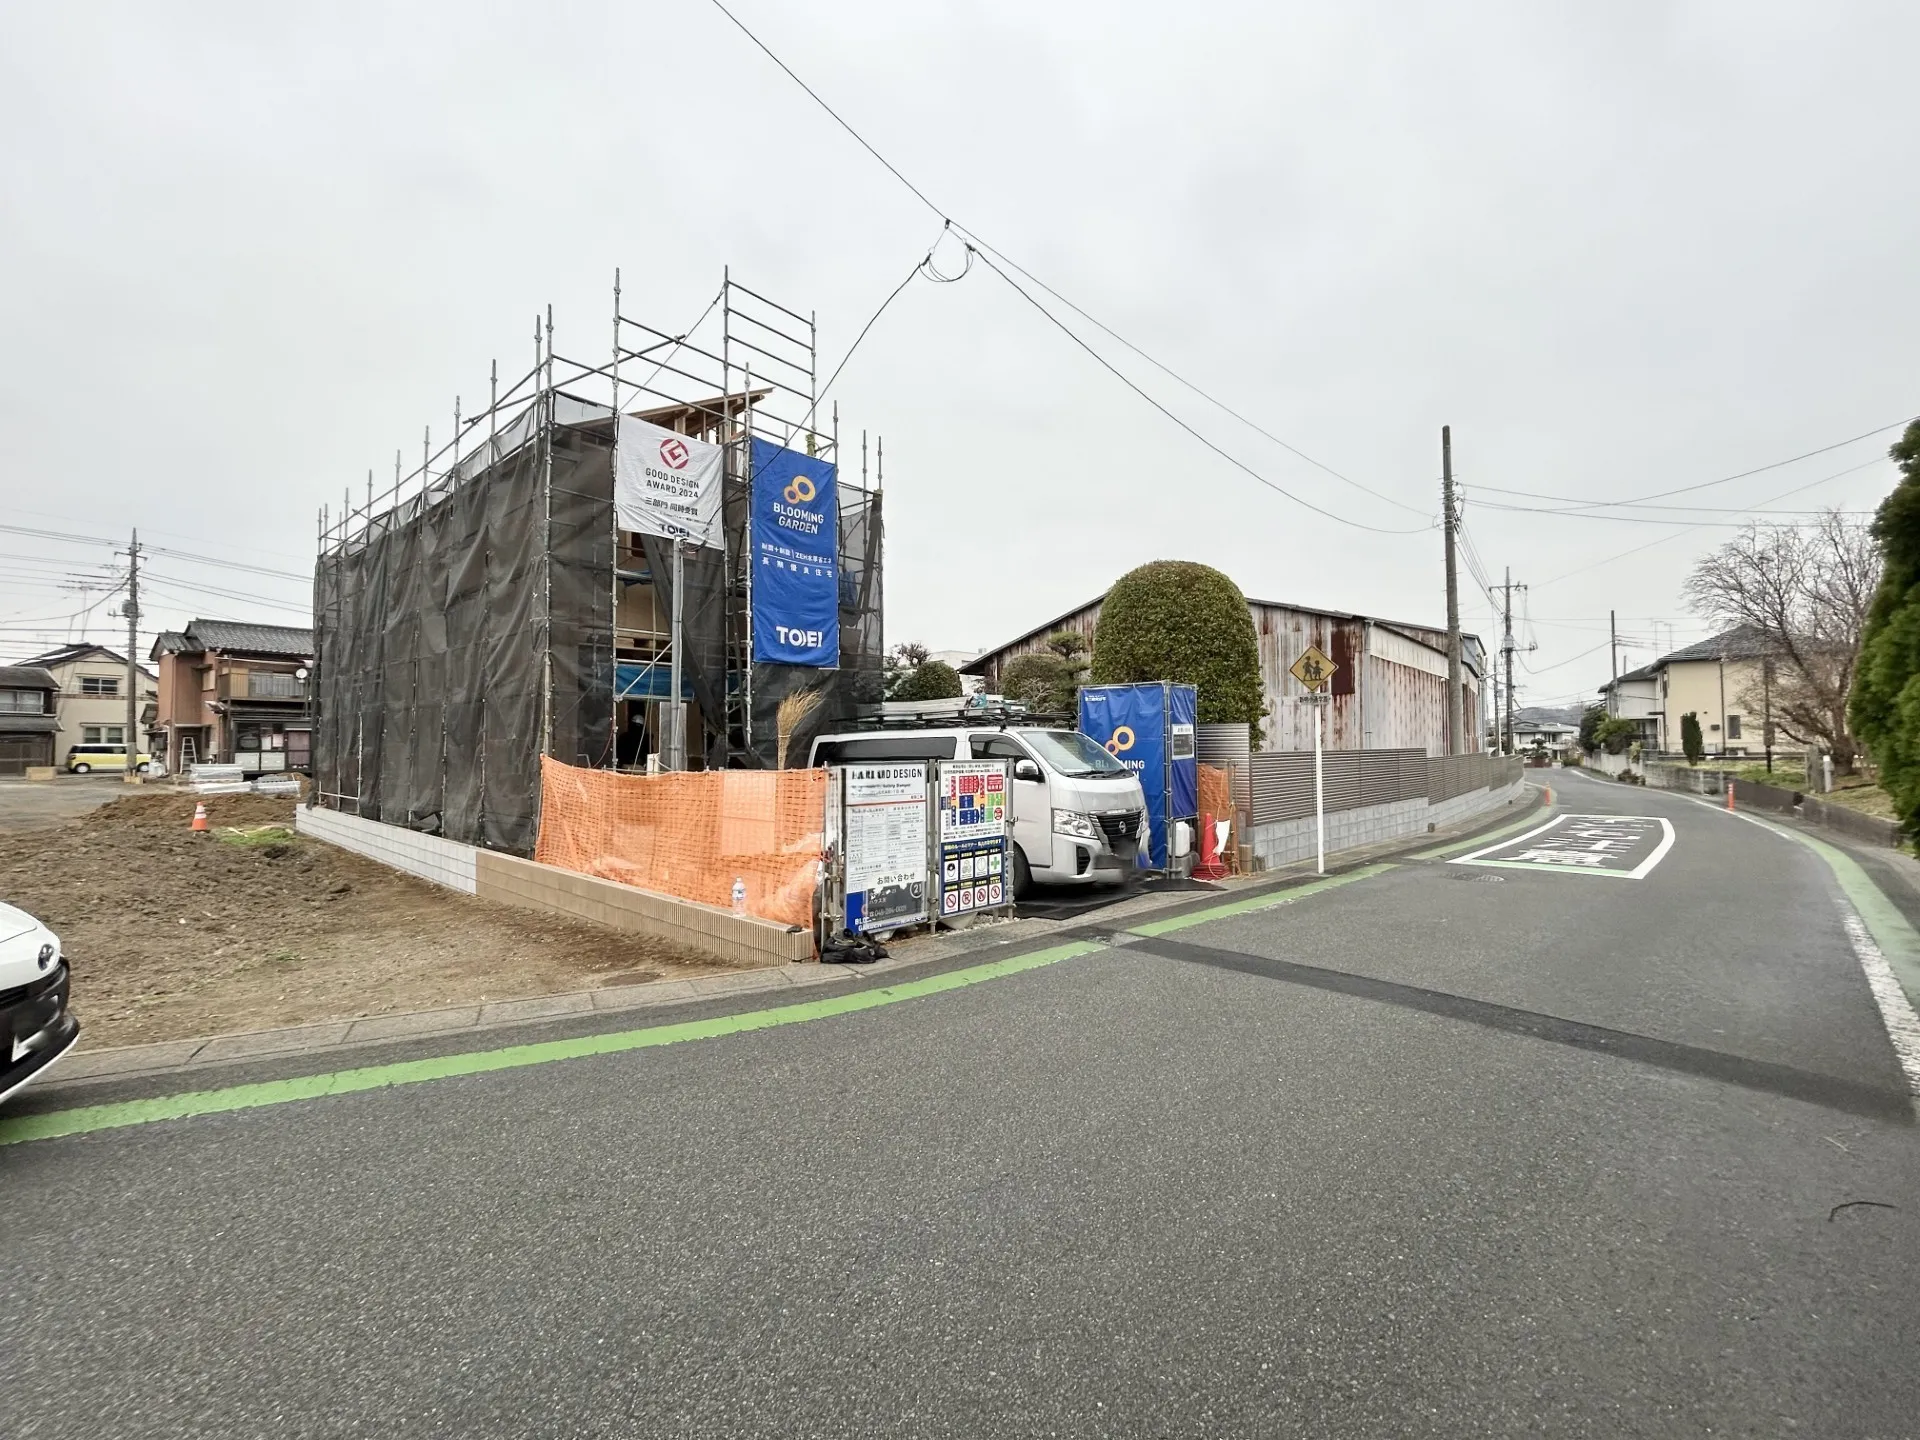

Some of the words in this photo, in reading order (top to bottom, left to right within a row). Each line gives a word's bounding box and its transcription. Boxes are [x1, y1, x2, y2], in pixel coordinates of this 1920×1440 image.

[645, 467, 668, 481] GOOD
[670, 475, 699, 489] DESIGN
[646, 479, 677, 494] AWARD
[679, 488, 699, 498] 2024
[644, 496, 668, 509] 三部門
[773, 502, 824, 524] BLOOMING
[778, 516, 818, 535] GARDEN
[775, 626, 823, 648] TOEI
[893, 768, 922, 779] DESIGN
[877, 872, 915, 885] お問い合わせ
